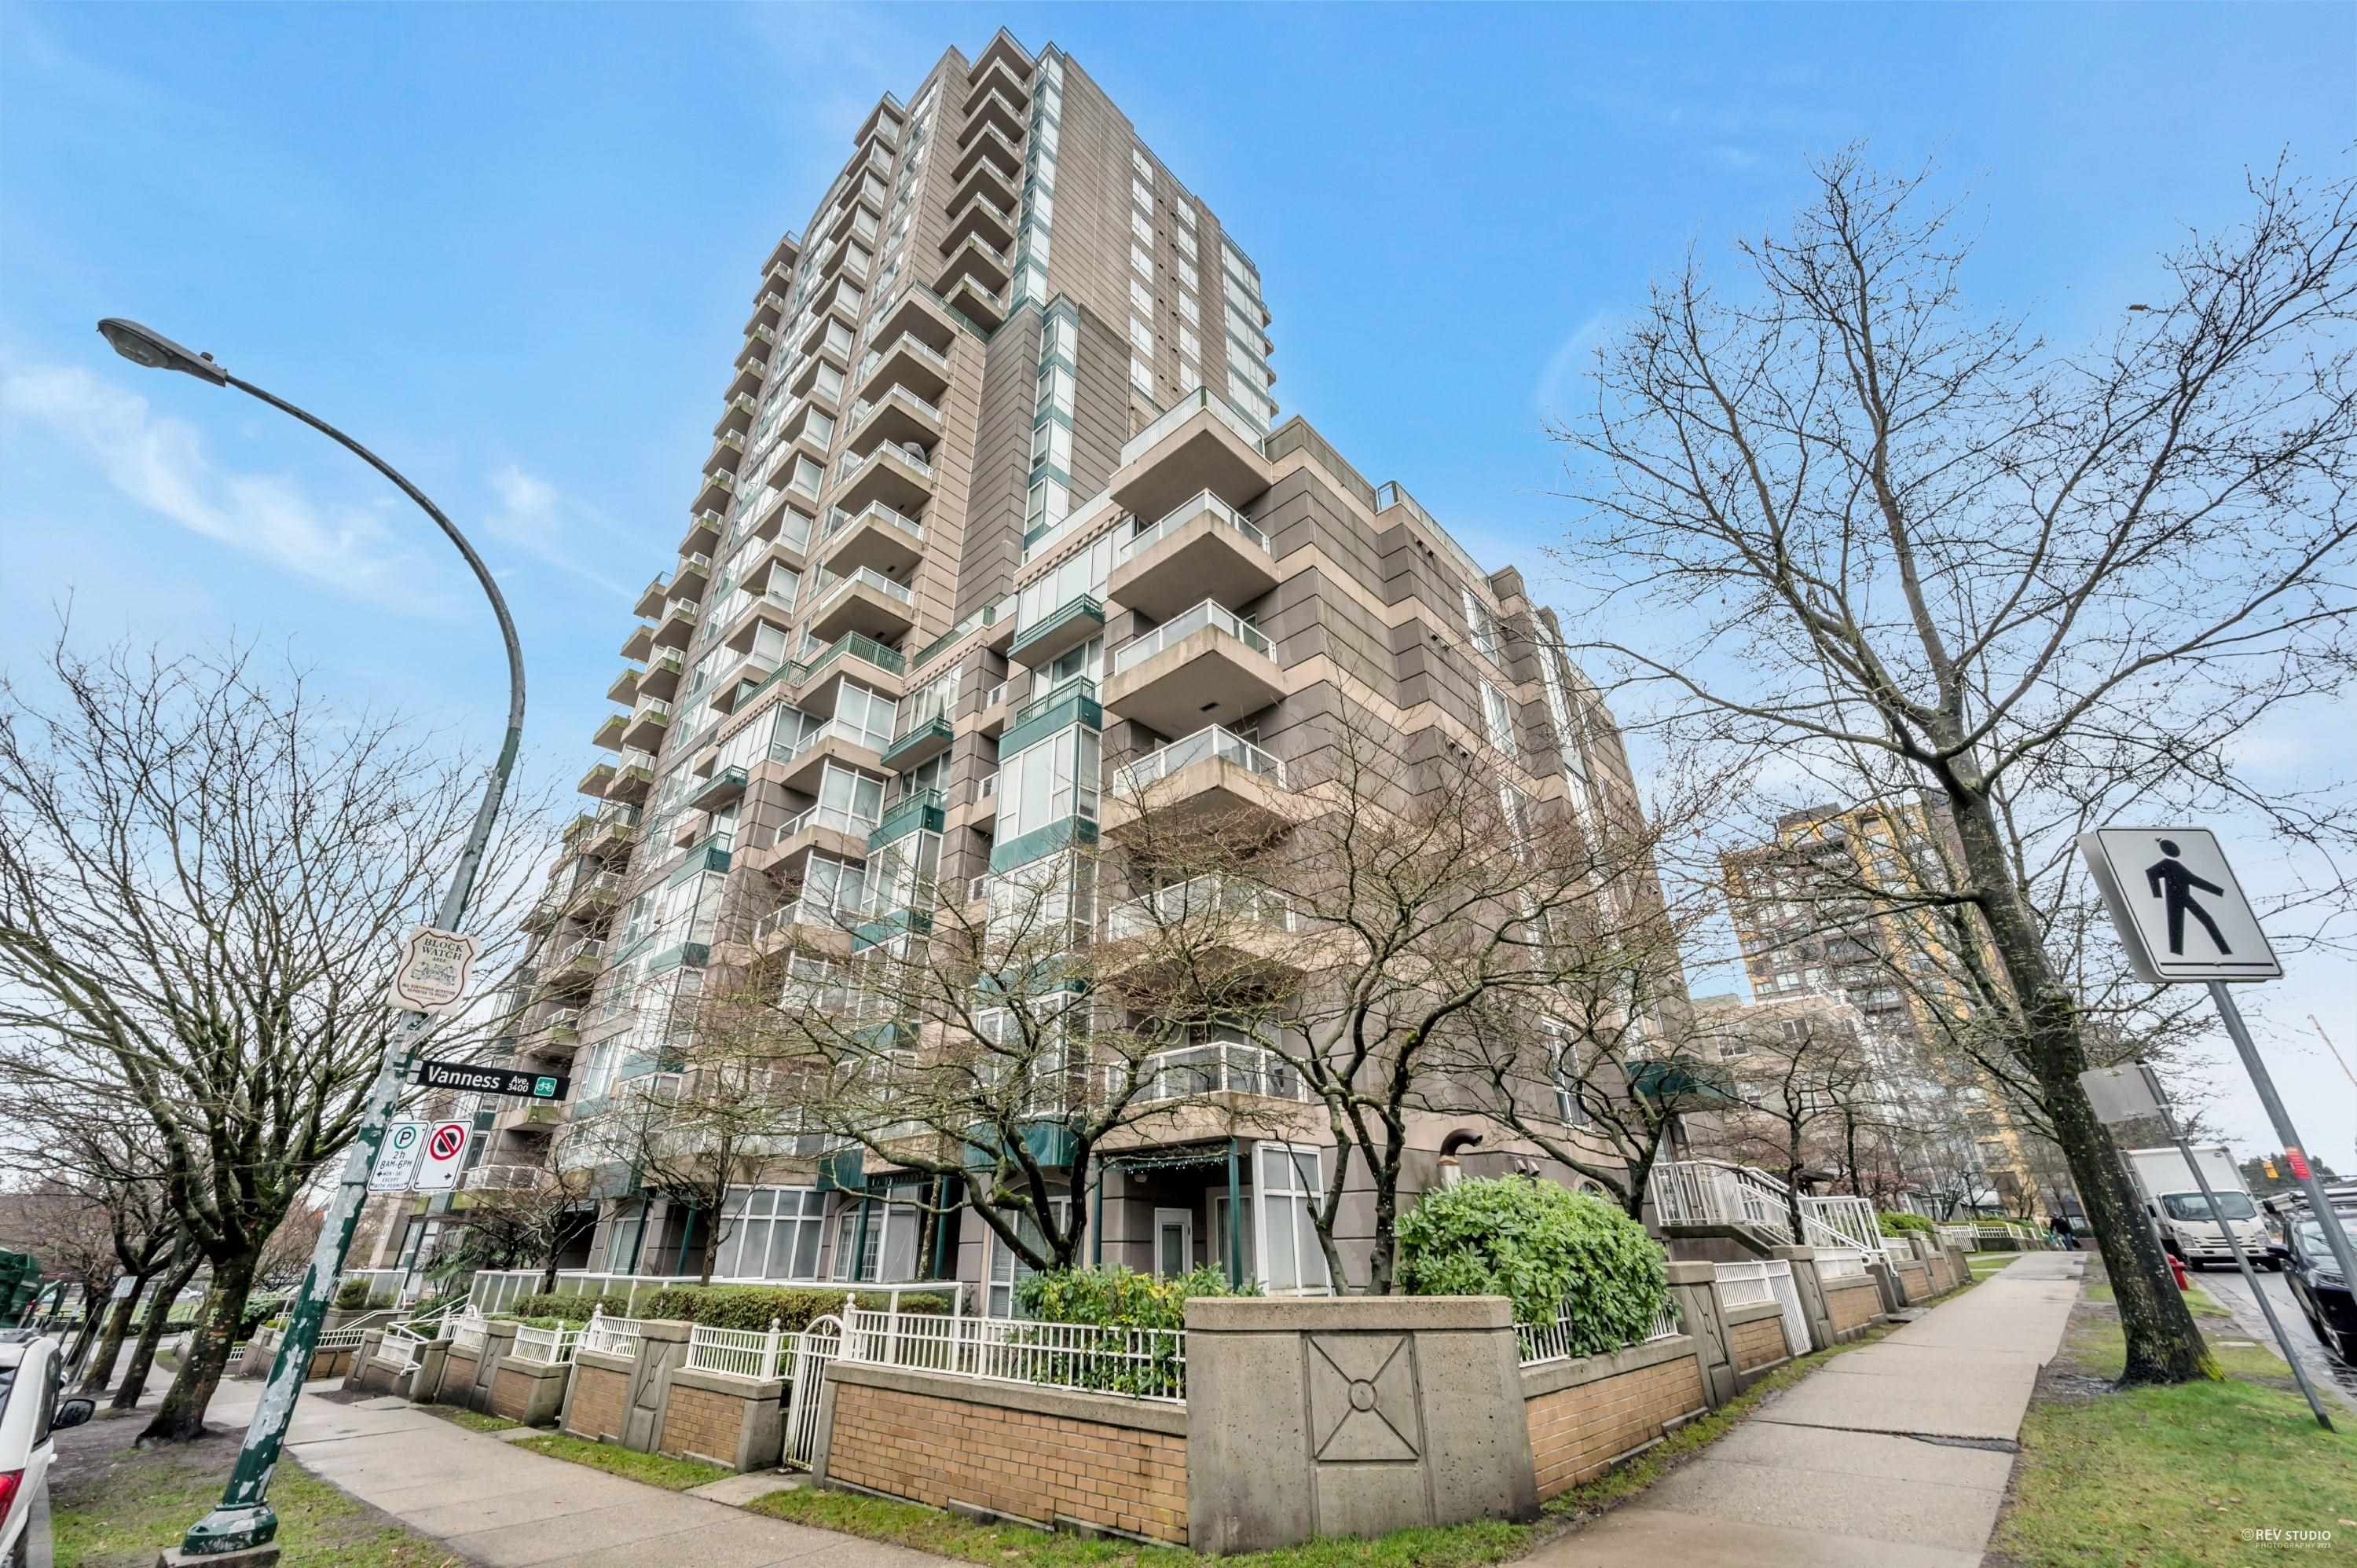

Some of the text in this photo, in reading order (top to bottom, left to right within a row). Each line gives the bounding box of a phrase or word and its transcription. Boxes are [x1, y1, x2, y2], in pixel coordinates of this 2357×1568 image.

[425, 939, 463, 952] BLOCK
[423, 946, 462, 961] WATCH
[428, 1065, 530, 1089] Vanness Ave.
[507, 1083, 529, 1093] 3400
[398, 1131, 411, 1144] P
